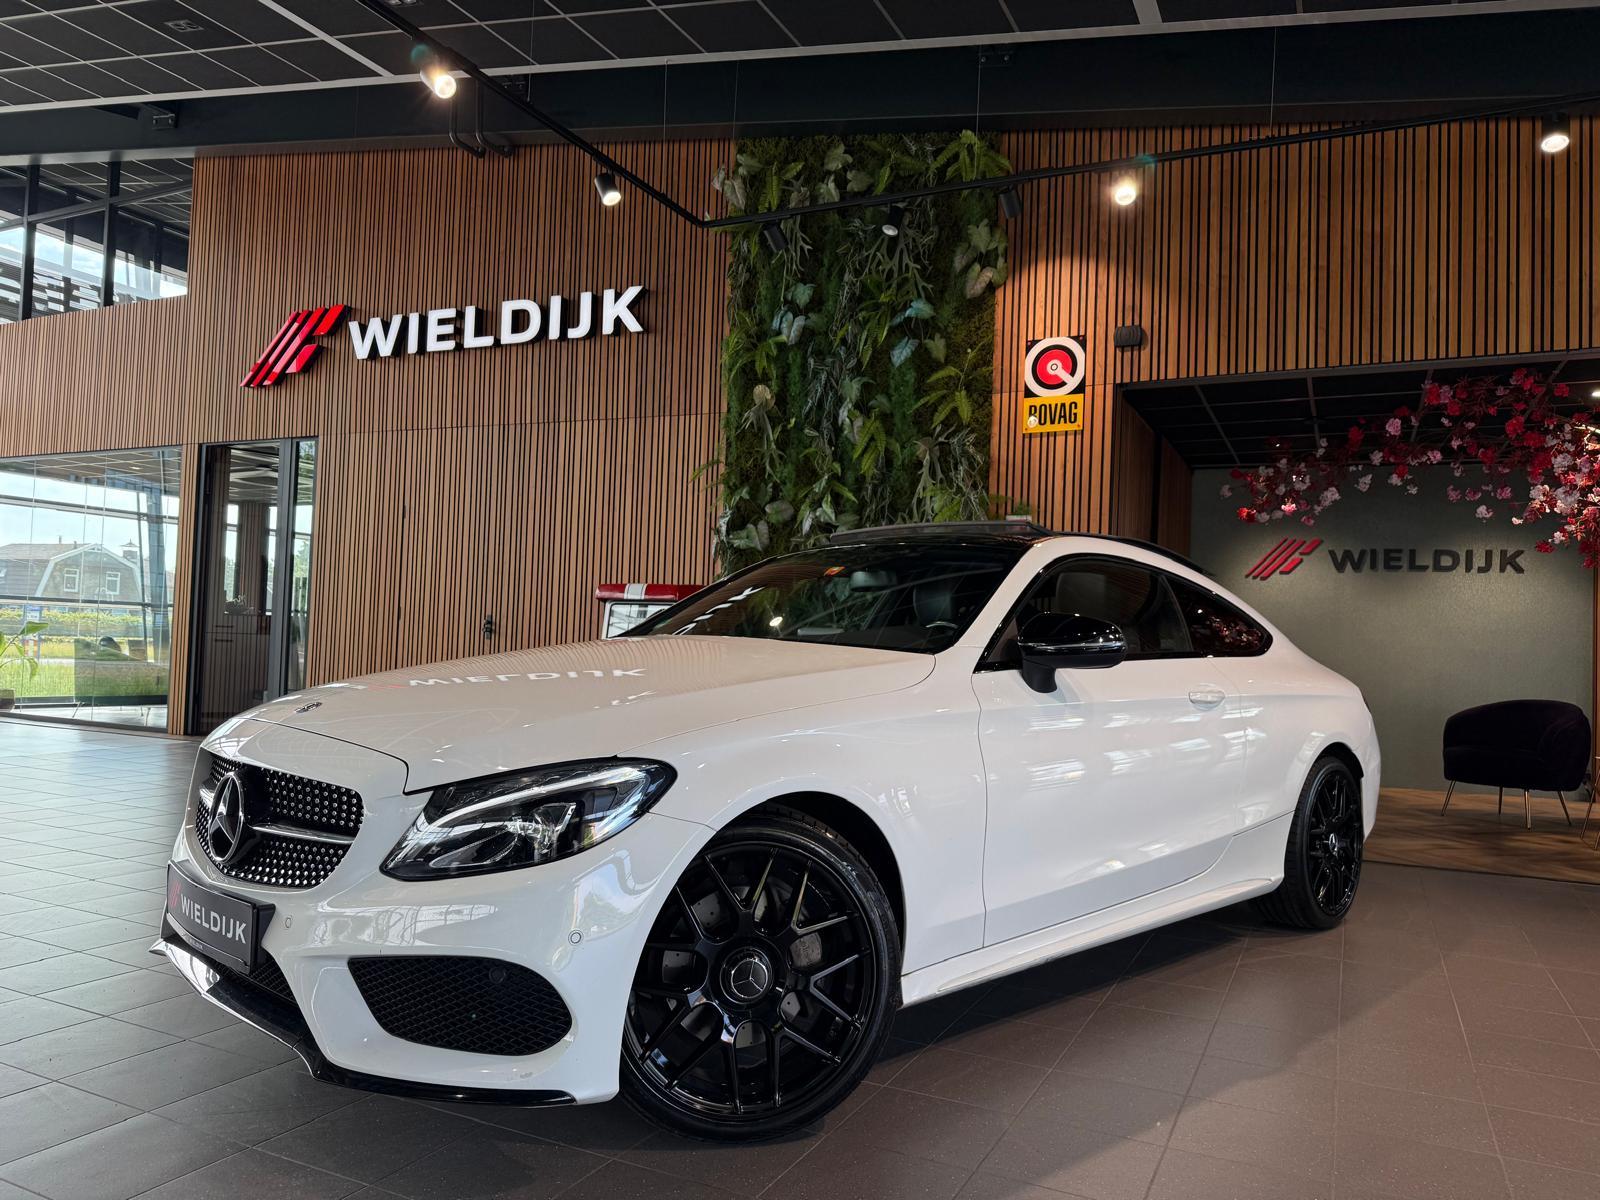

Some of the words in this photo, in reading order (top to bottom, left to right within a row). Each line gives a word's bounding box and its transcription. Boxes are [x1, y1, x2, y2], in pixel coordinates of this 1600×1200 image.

[348, 285, 644, 360] WIELDIJK
[1328, 548, 1525, 574] WIELDIJK
[181, 894, 247, 944] WIELDIJK
